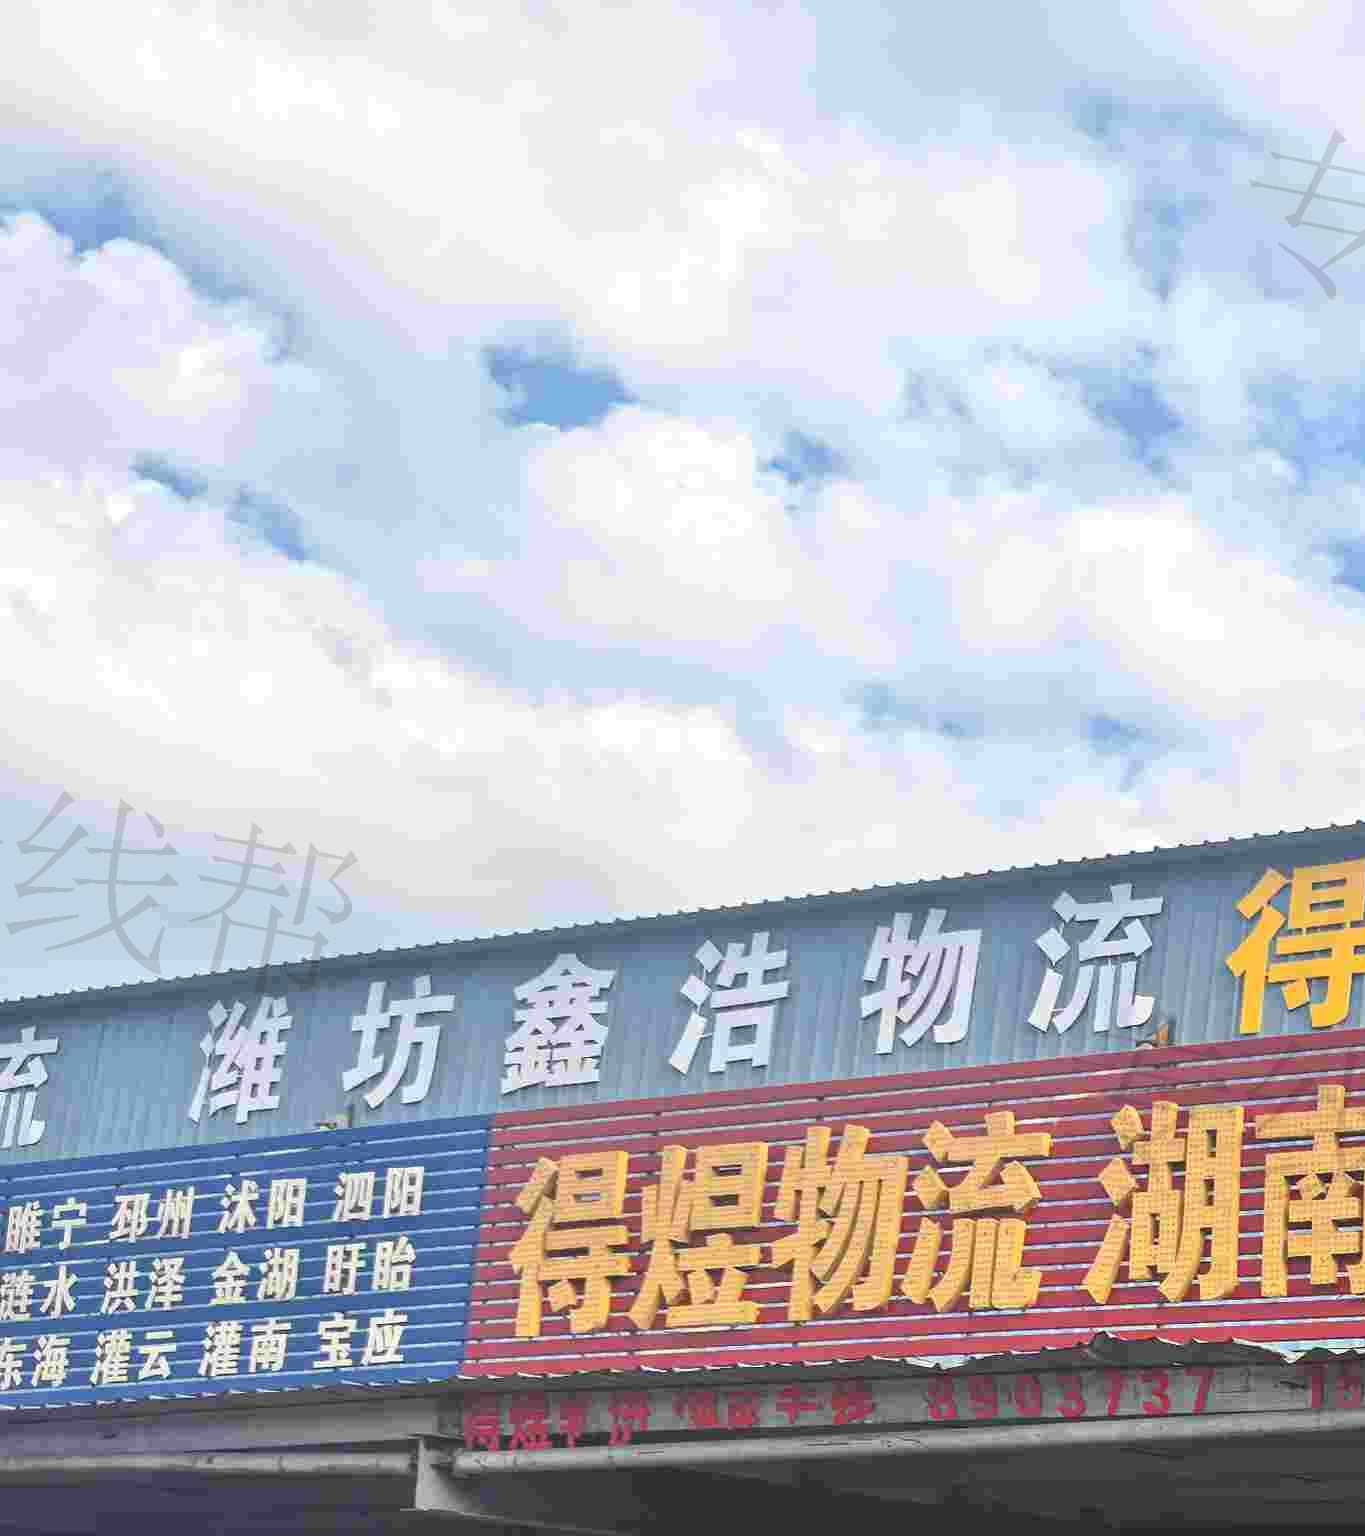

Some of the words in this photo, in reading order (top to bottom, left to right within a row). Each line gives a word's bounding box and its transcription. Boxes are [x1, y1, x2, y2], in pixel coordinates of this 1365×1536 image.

[188, 883, 1164, 1124] 潍坊鑫浩物流
[109, 1186, 196, 1243] 邳州
[333, 1166, 424, 1222] 泗阳
[0, 1264, 79, 1322] 涟水
[101, 1255, 186, 1315] 洪泽
[209, 1247, 301, 1305] 金湖
[323, 1236, 417, 1296] 盱眙
[0, 1334, 70, 1387] 东海
[91, 1328, 176, 1385] 灌云
[198, 1318, 291, 1378] 灌南
[313, 1309, 408, 1370] 宝应
